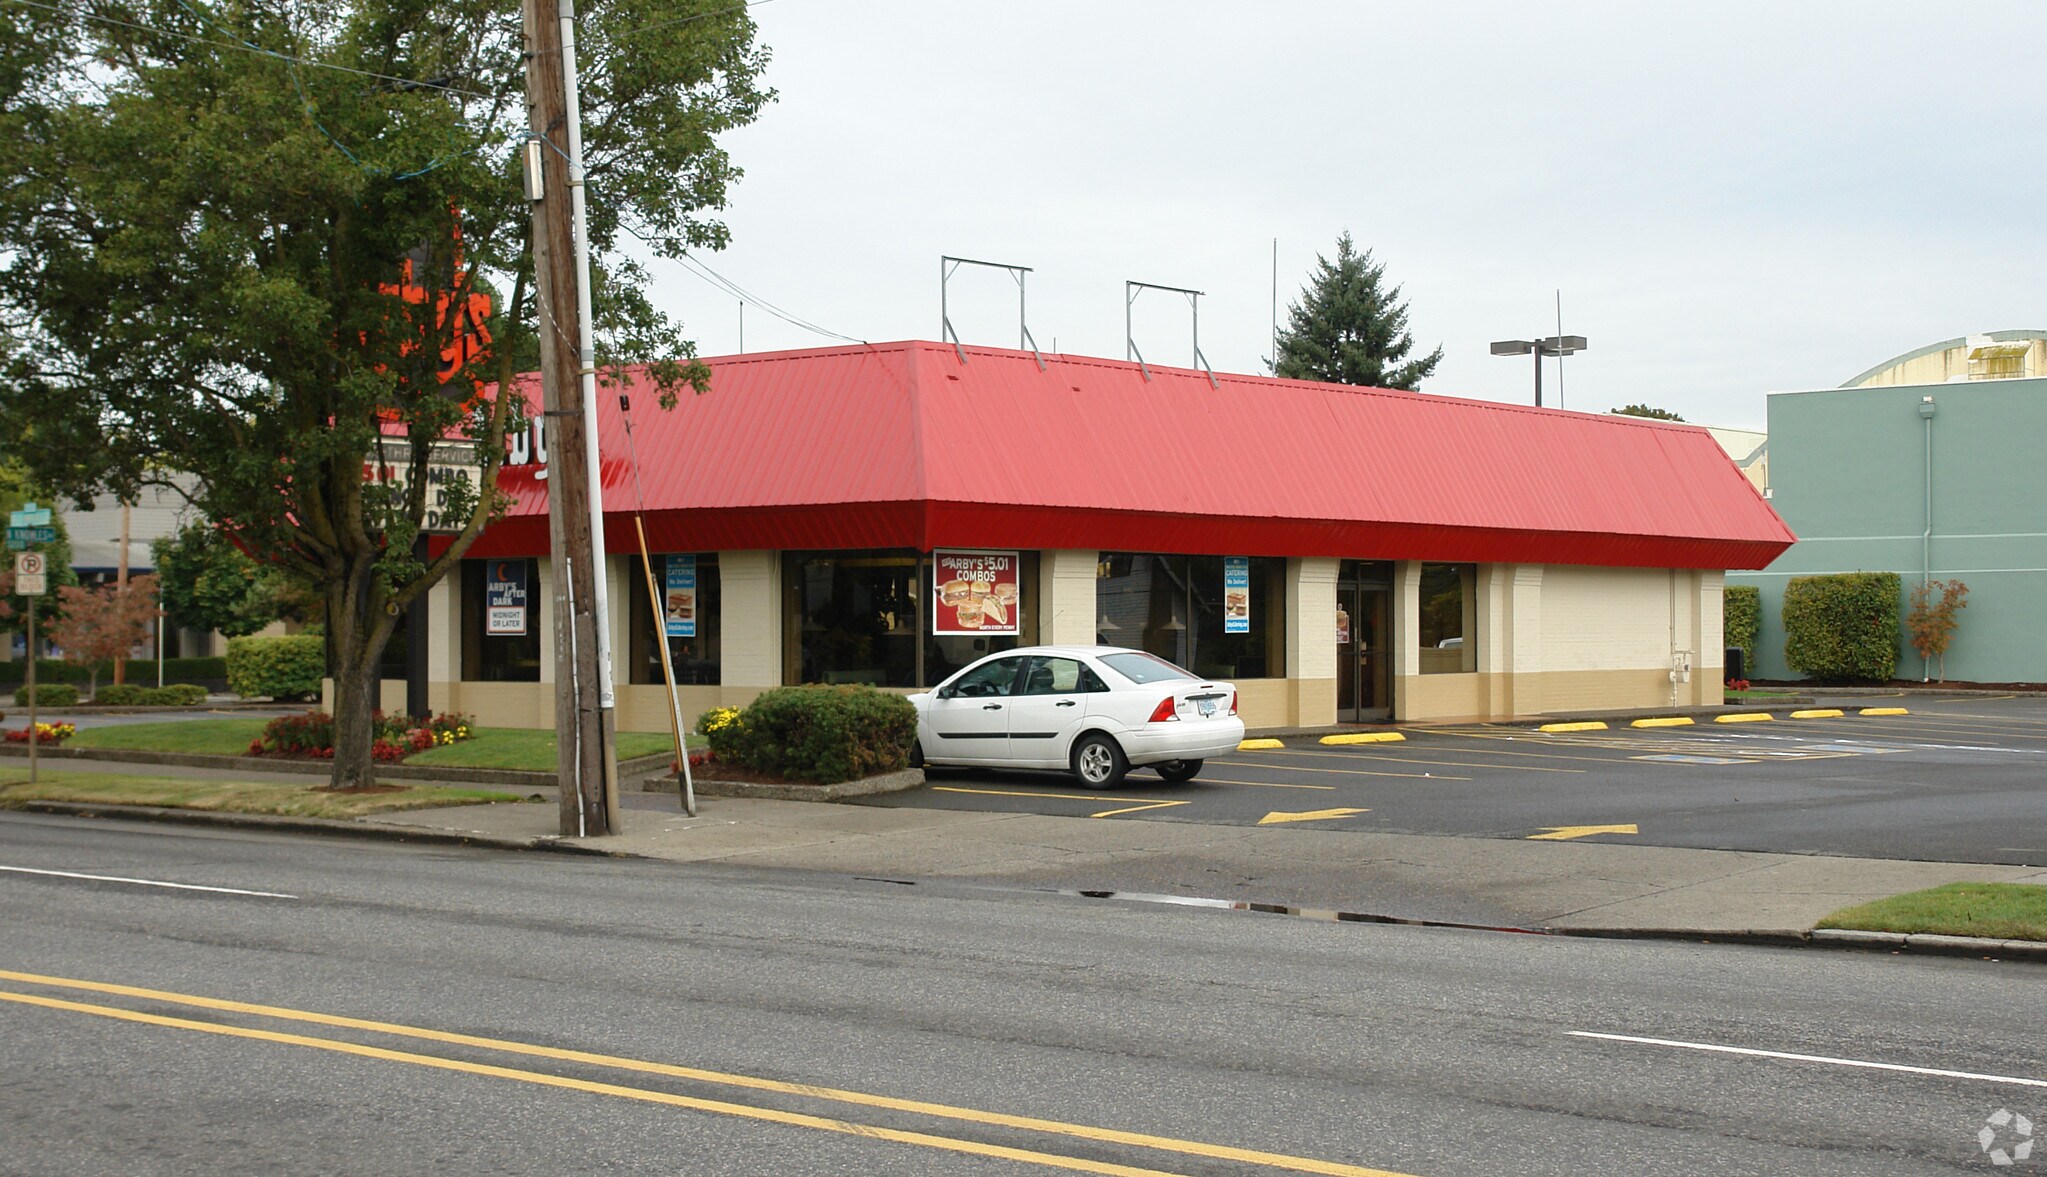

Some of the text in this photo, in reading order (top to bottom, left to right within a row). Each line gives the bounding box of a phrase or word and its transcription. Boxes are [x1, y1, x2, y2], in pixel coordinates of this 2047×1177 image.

[14, 529, 48, 541] KNOWLES
[948, 557, 984, 570] ARBY'S
[984, 556, 1009, 571] $5.01
[668, 568, 695, 576] CATERING
[956, 570, 996, 582] COMBOS
[488, 582, 517, 592] ARBY'S
[503, 589, 525, 598] AFTER
[492, 597, 513, 606] DARK
[492, 611, 520, 619] MIDNIGHT
